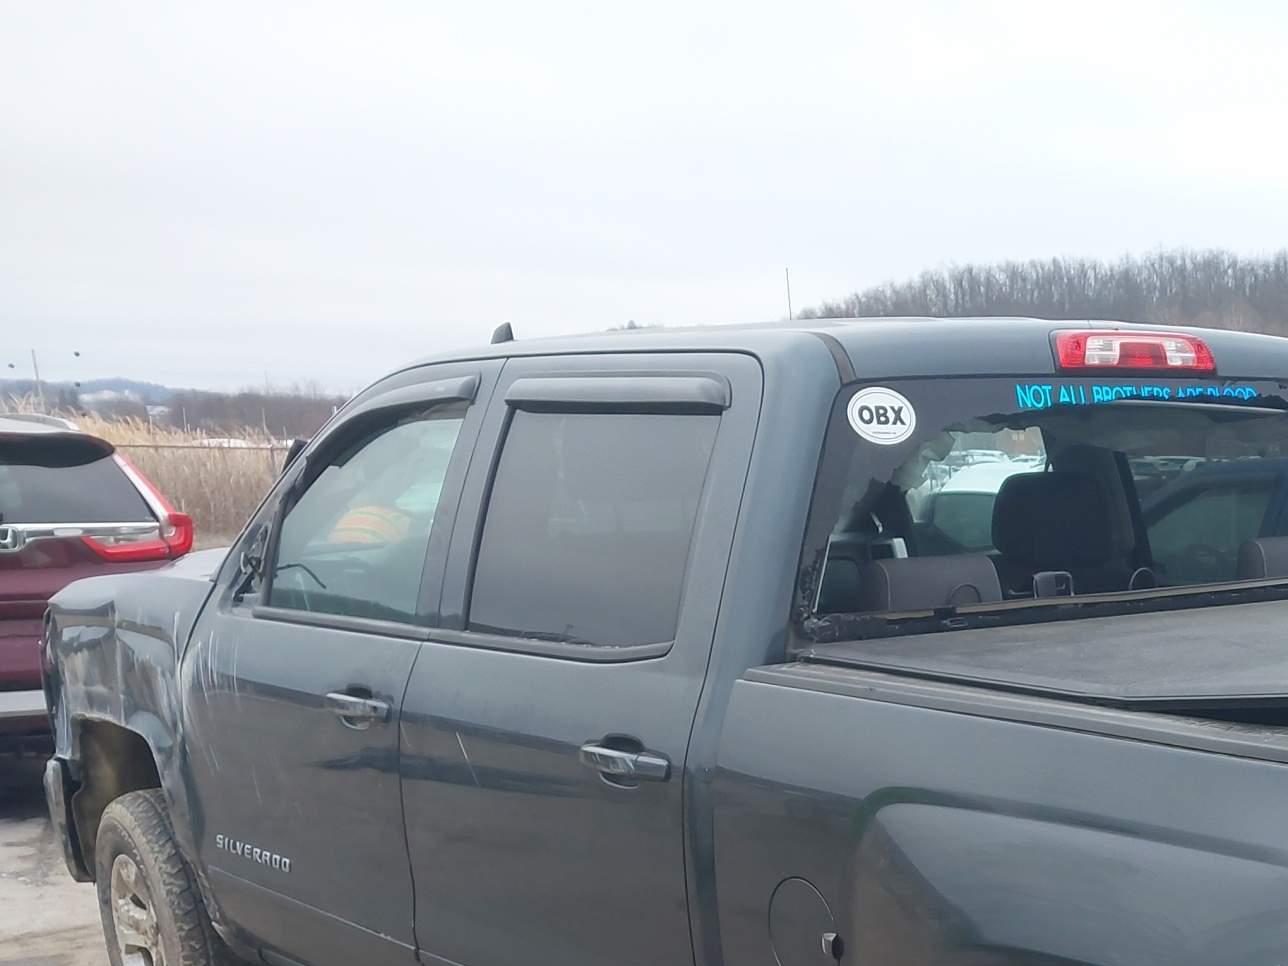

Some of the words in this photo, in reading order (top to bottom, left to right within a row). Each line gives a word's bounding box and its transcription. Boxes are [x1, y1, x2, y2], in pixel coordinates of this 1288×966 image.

[1016, 384, 1052, 409] NOT
[858, 405, 906, 426] OBX
[215, 834, 291, 873] SILVERADO
